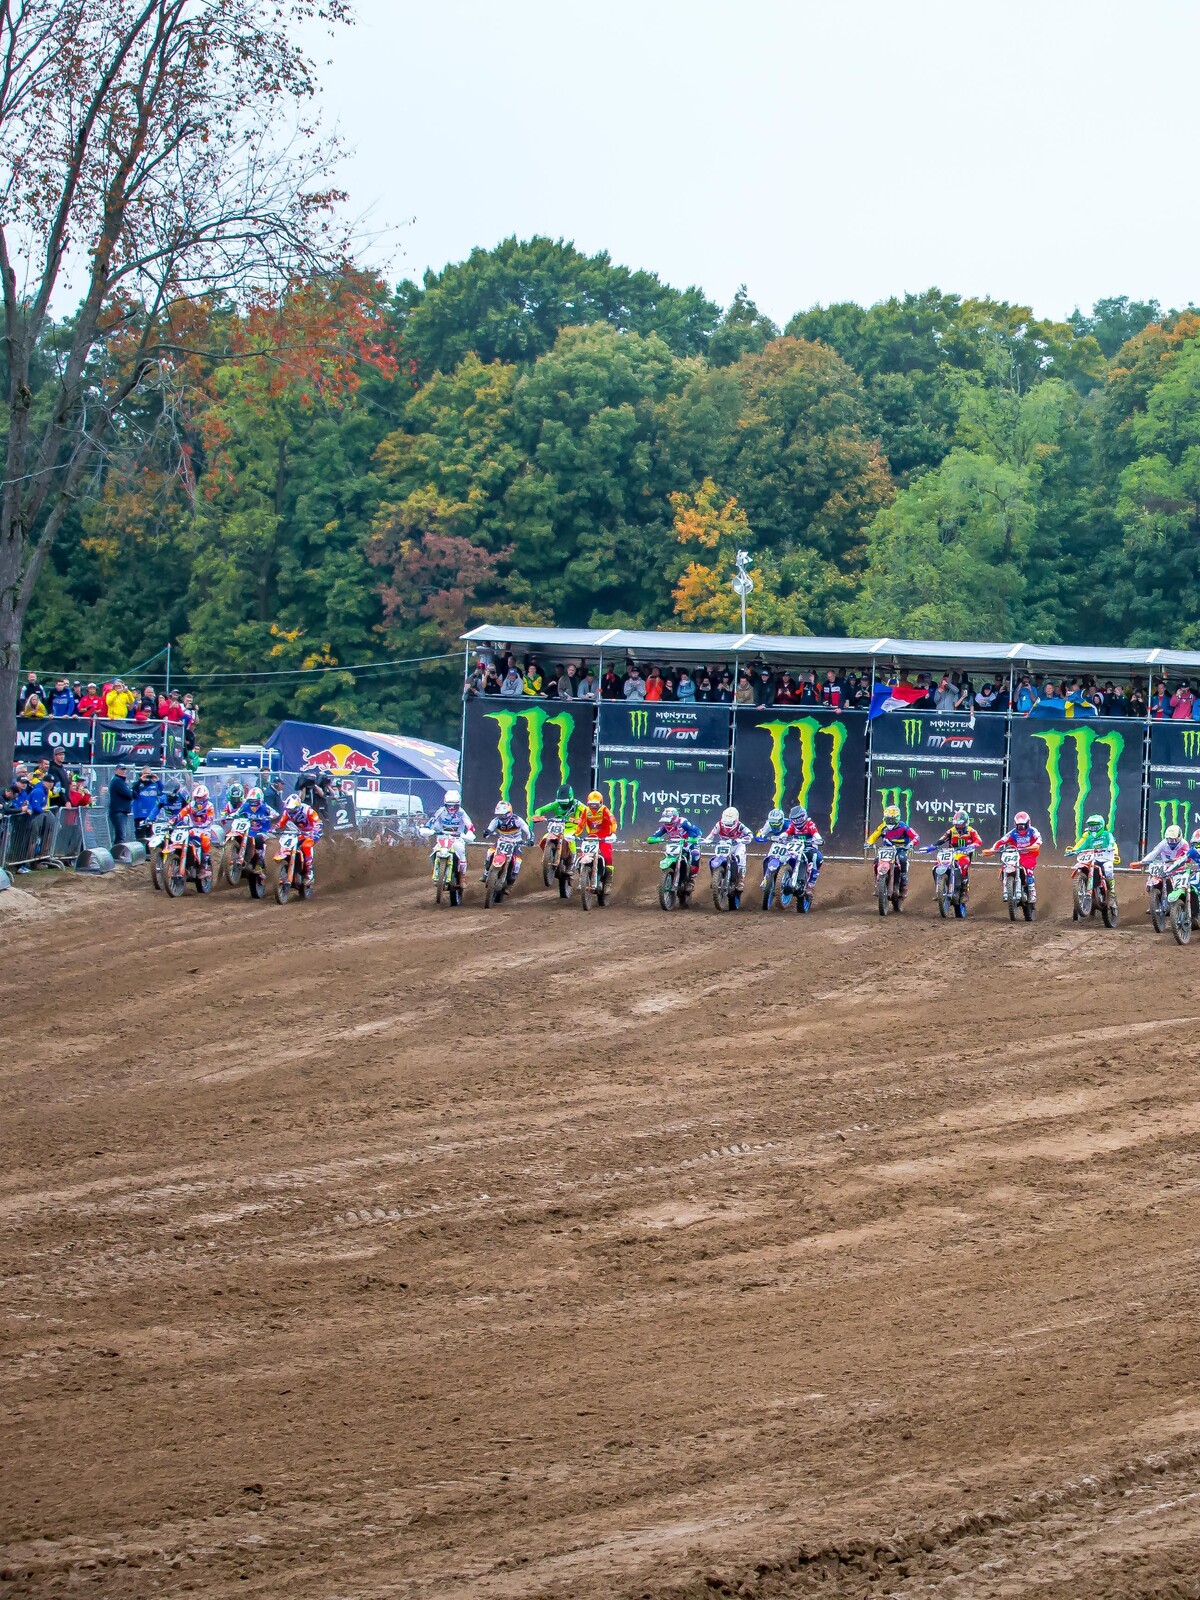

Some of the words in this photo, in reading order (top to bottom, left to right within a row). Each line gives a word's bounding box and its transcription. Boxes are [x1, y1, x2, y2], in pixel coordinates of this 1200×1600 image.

[656, 711, 697, 720] MONSTER
[48, 732, 88, 748] OUT
[642, 790, 722, 806] MONSTER
[916, 799, 997, 815] MONSTER
[336, 810, 349, 824] 2
[235, 822, 246, 830] 19
[175, 833, 182, 841] 6
[284, 838, 291, 847] 4
[787, 842, 801, 851] 27
[584, 844, 595, 853] 52
[774, 846, 786, 856] 30
[880, 851, 895, 859] 129
[1176, 878, 1188, 887] 21
